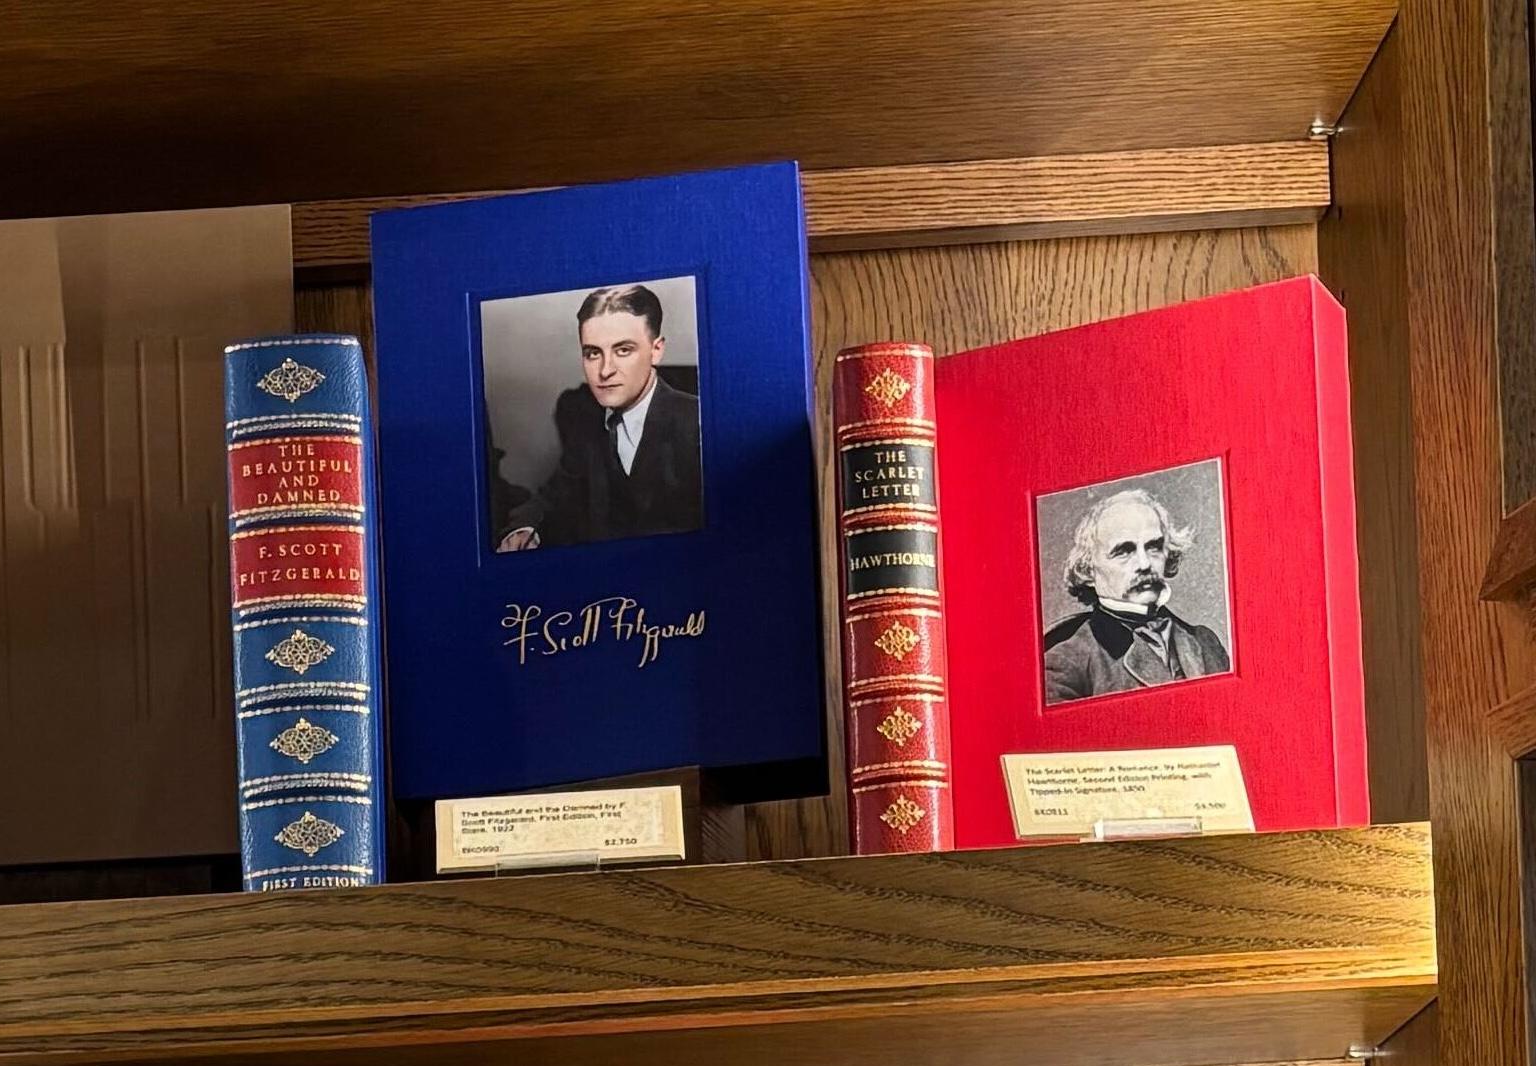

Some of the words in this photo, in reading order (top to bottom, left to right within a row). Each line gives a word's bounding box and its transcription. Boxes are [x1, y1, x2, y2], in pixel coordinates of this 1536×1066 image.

[278, 444, 315, 457] THE
[874, 450, 906, 463] THE
[242, 460, 352, 477] BEAUTIFUL
[855, 466, 925, 483] SCARLET
[279, 475, 319, 488] AND
[257, 490, 340, 504] DAMNED
[862, 483, 920, 499] LETTER
[259, 547, 272, 559] F.
[279, 544, 343, 556] SCOTT
[850, 552, 935, 571] HAWTHORNE
[240, 568, 360, 586] FITZGERALD
[262, 878, 296, 891] FIRST
[304, 876, 360, 888] EDITION
